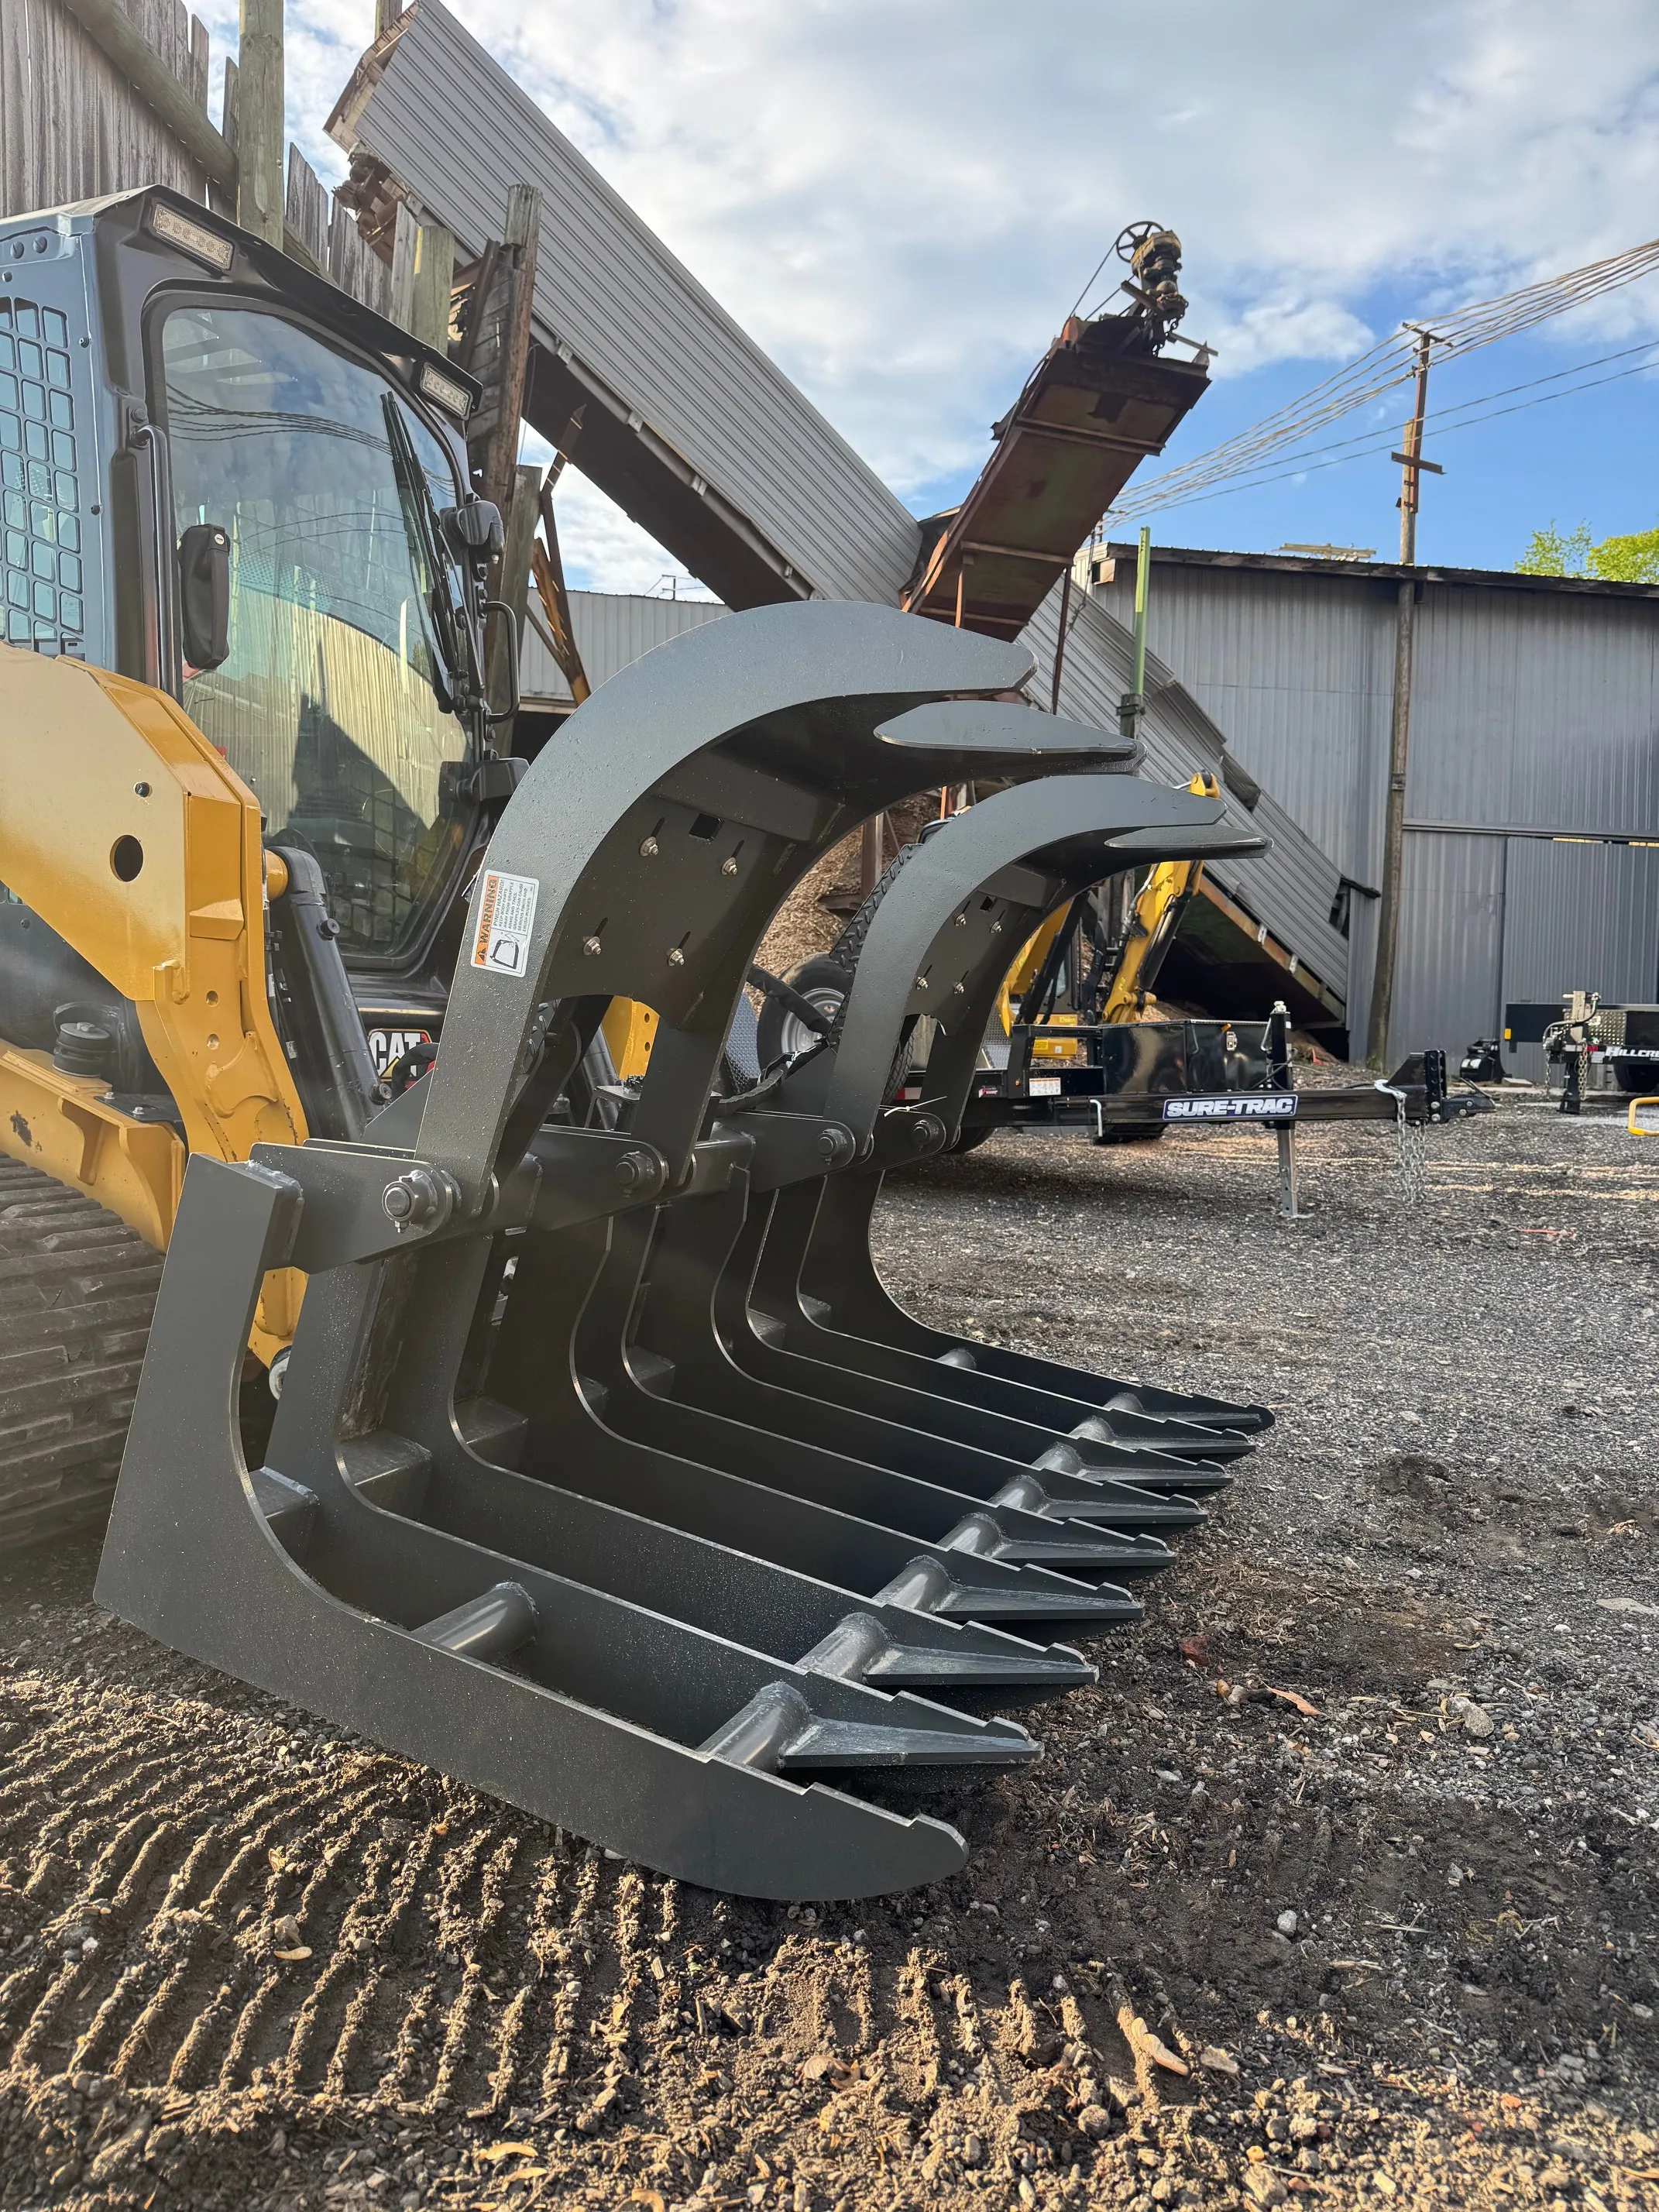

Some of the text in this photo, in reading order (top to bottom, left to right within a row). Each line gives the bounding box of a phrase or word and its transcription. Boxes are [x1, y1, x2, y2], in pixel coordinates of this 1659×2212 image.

[480, 879, 496, 943] WARNING
[369, 1032, 421, 1077] CAT
[1167, 1097, 1293, 1117] SURE-TRAC
